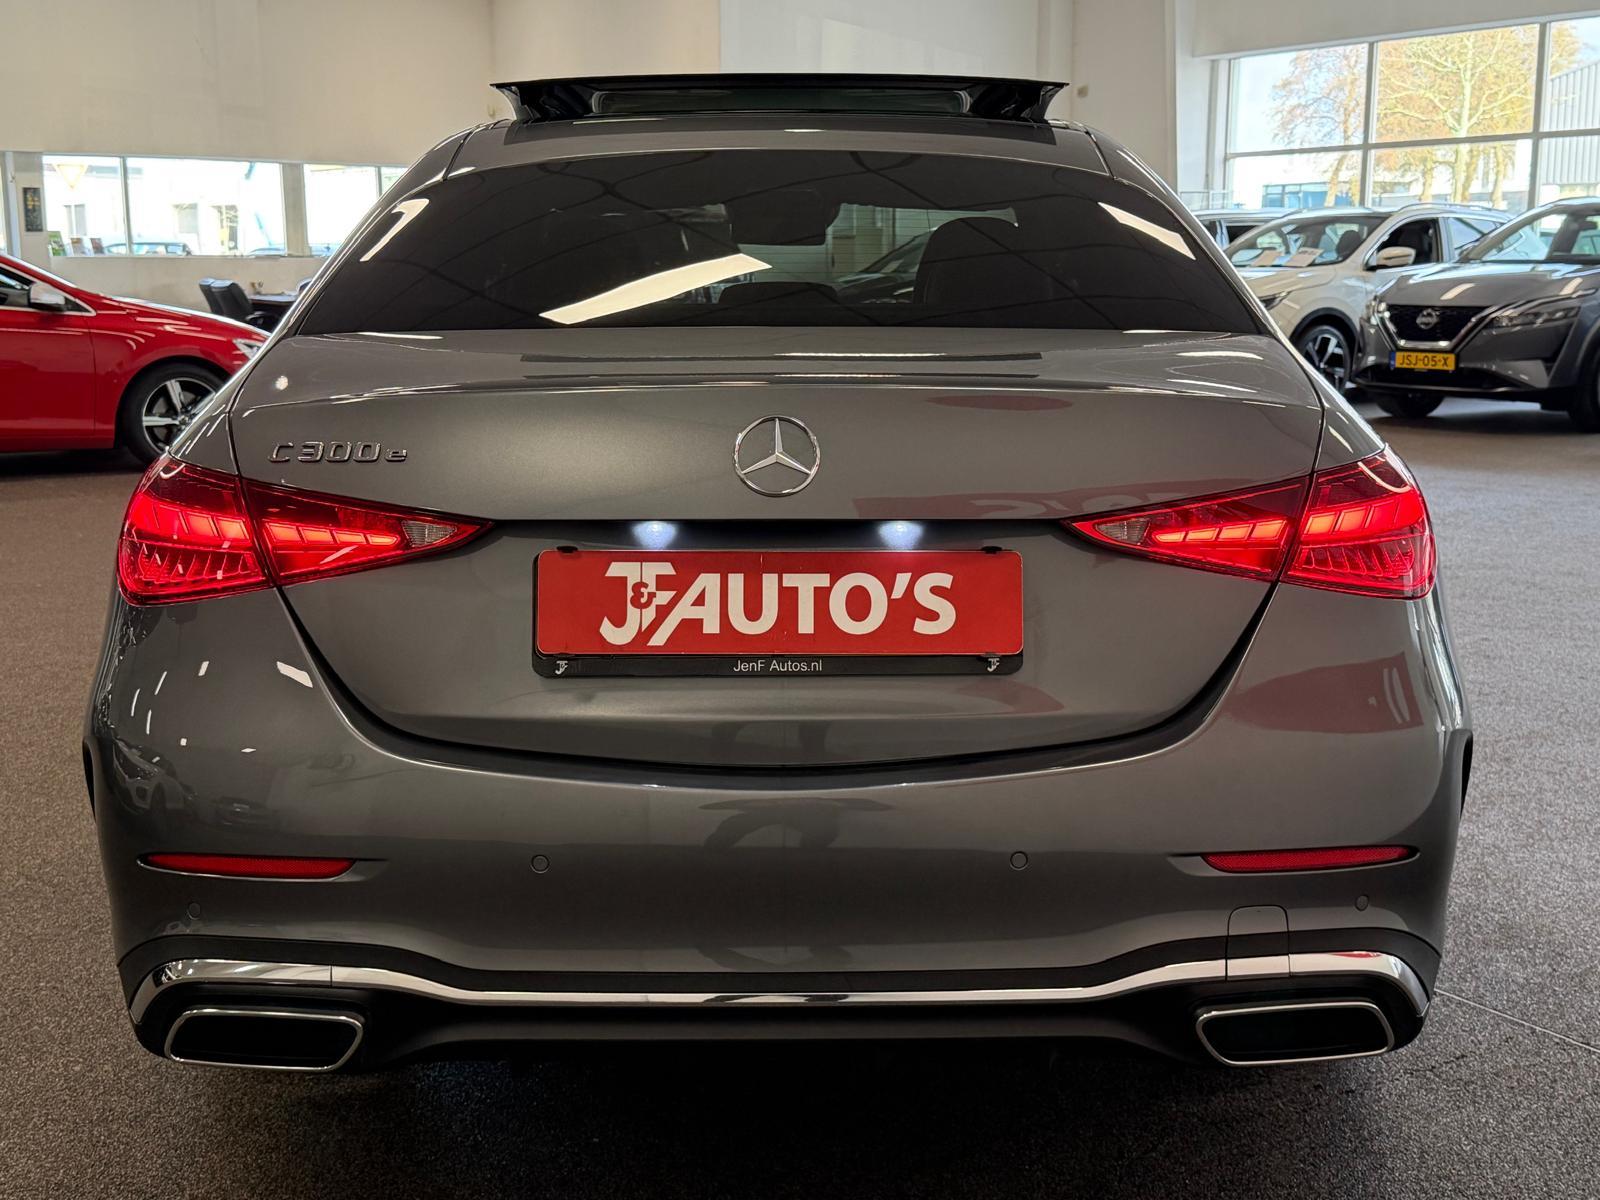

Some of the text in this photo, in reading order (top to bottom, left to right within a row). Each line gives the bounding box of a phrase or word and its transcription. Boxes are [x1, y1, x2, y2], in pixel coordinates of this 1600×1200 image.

[1399, 354, 1450, 368] JSJ-05-X
[733, 659, 823, 672] JenF Autos.nl
